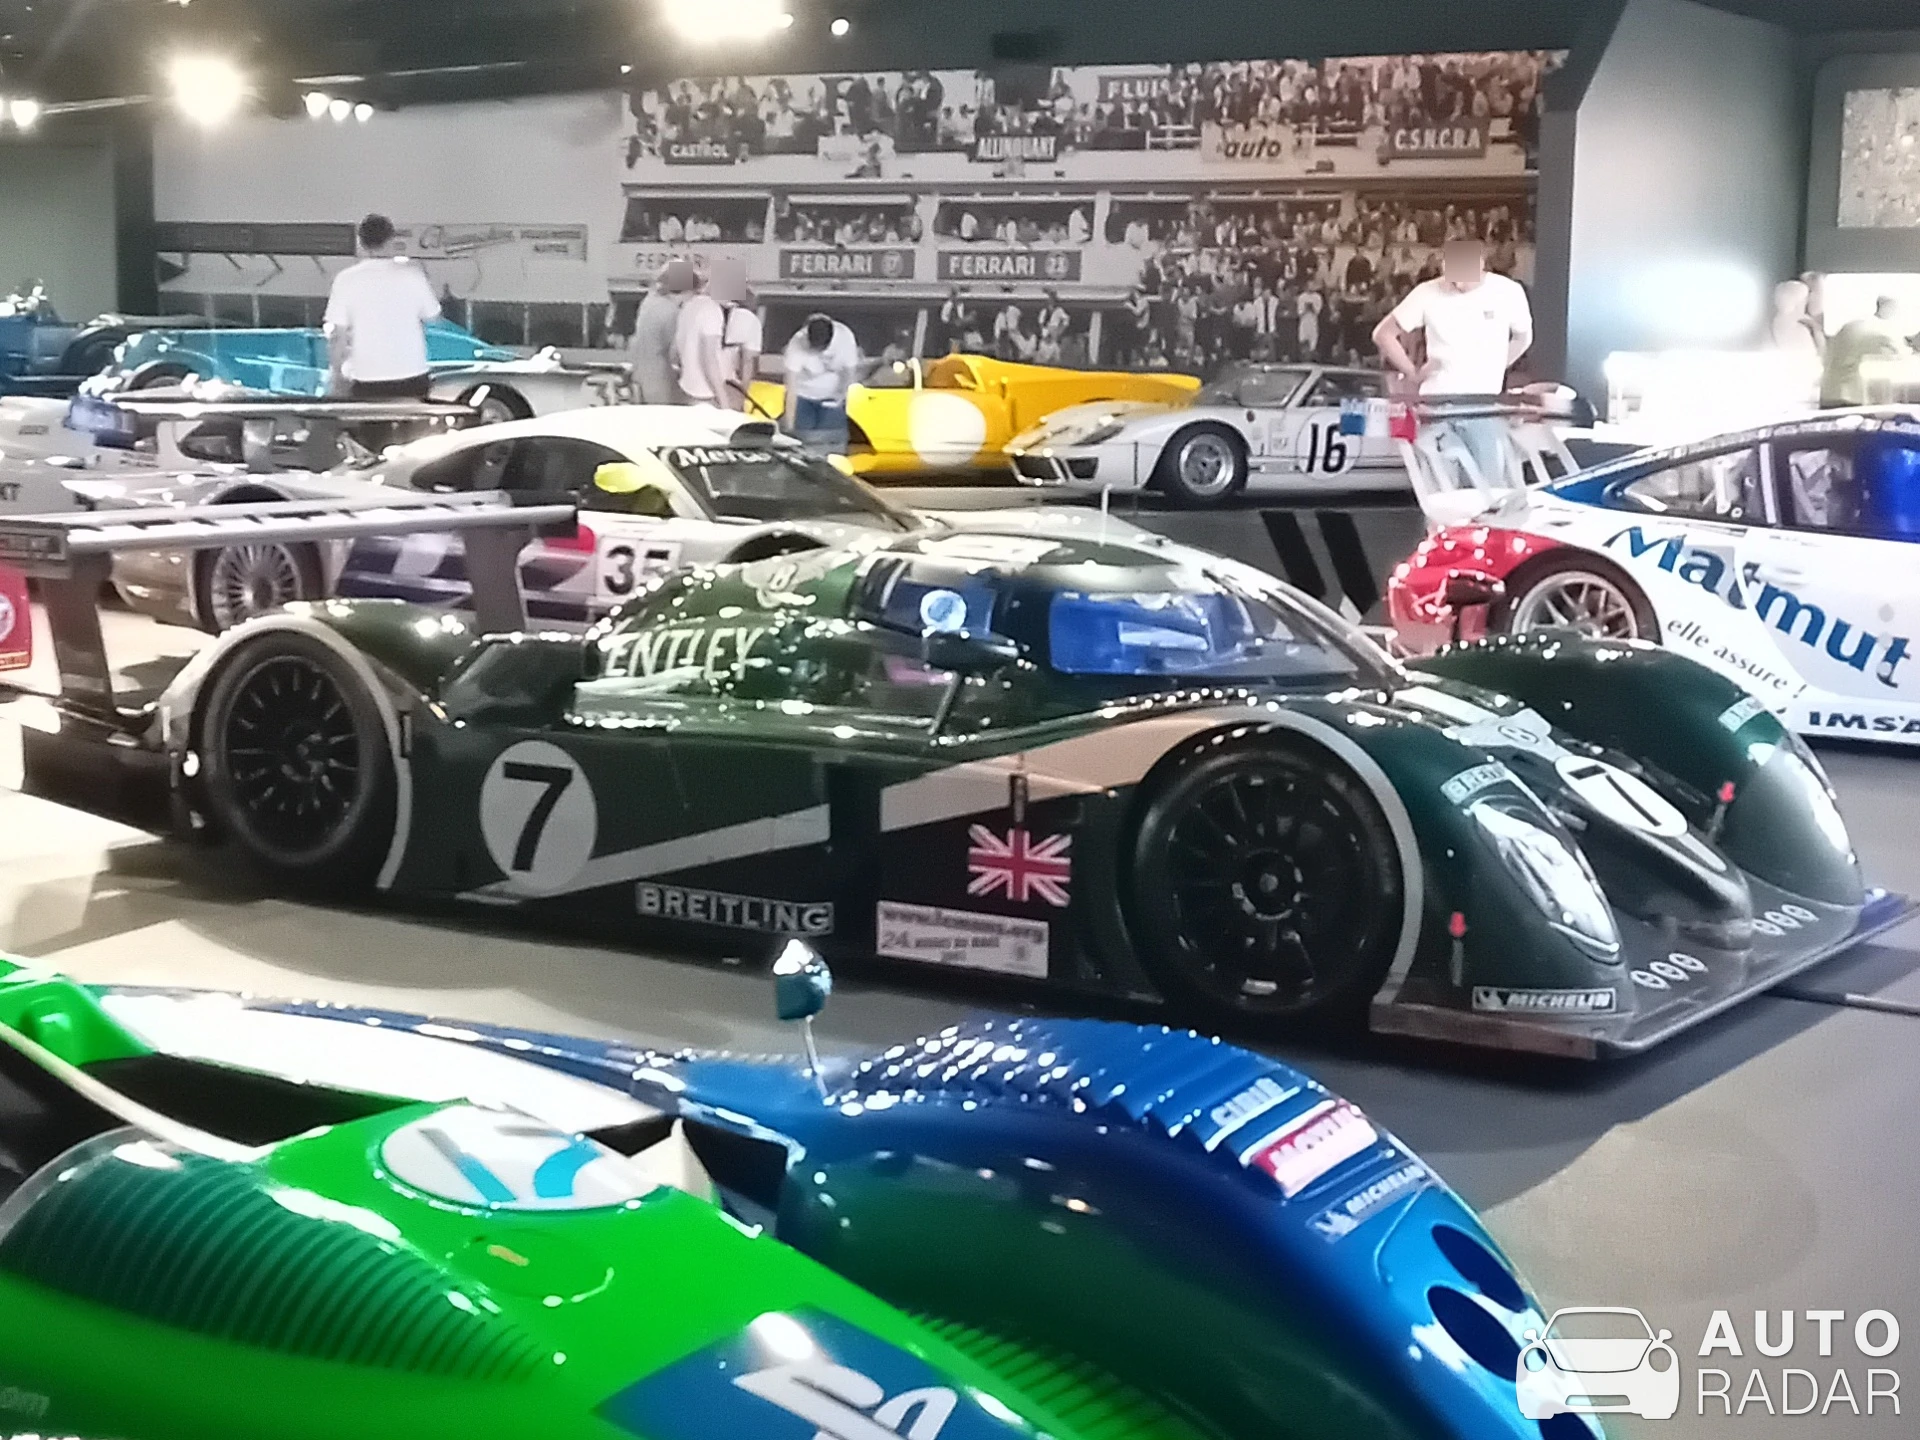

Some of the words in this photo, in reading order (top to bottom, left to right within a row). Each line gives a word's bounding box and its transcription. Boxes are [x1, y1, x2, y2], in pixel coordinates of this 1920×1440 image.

[790, 254, 873, 274] FERRARI
[949, 255, 1036, 276] FERRARI
[1305, 422, 1347, 473] 16
[1602, 525, 1912, 689] Matmut
[1667, 620, 1710, 648] elle
[1713, 645, 1788, 690] assure
[504, 762, 573, 871] 7
[1567, 765, 1662, 827] 7
[638, 886, 830, 932] BREITLING
[1507, 992, 1611, 1009] MICHELIN
